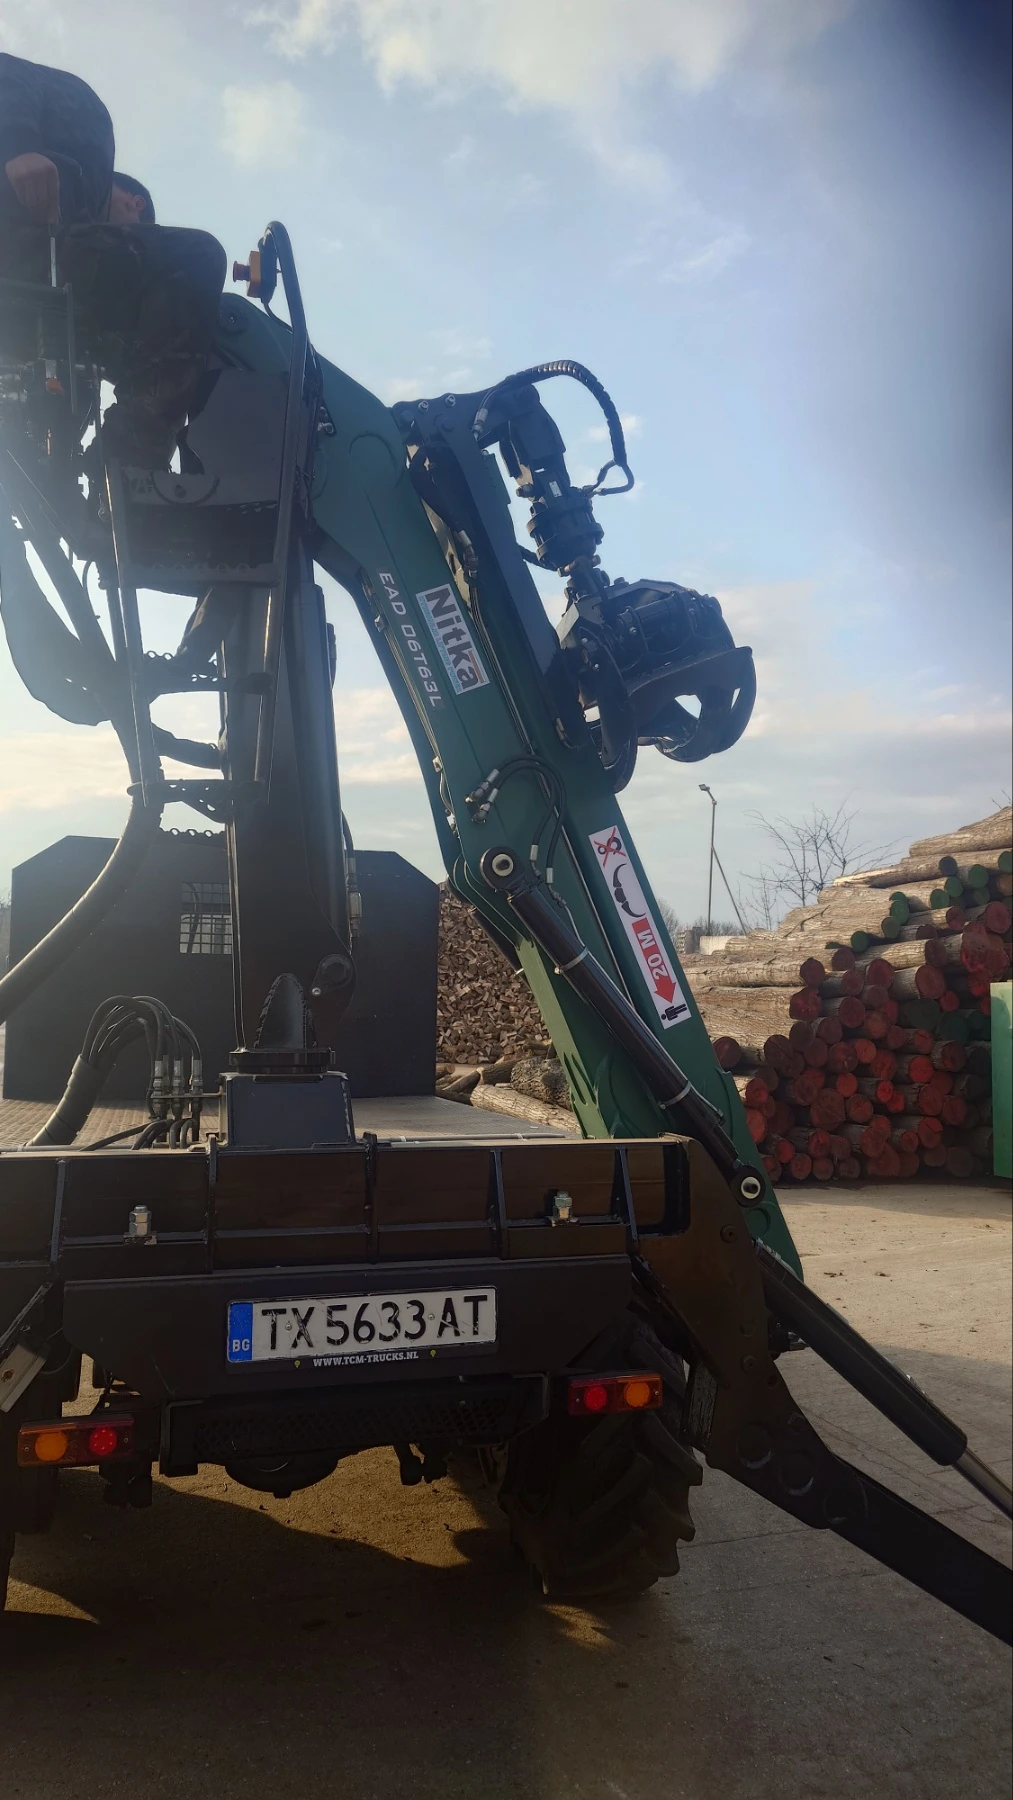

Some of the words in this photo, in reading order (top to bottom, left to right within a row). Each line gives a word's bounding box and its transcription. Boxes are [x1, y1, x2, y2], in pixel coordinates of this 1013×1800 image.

[378, 572, 407, 616] EAD
[425, 587, 479, 689] Nitka
[636, 928, 656, 948] M
[647, 953, 669, 980] 20
[261, 1306, 315, 1350] TX
[326, 1299, 426, 1346] 5633
[437, 1294, 488, 1338] AT
[231, 1338, 250, 1352] BG
[312, 1351, 419, 1367] WWW.TCM-TRUCKS.NL
